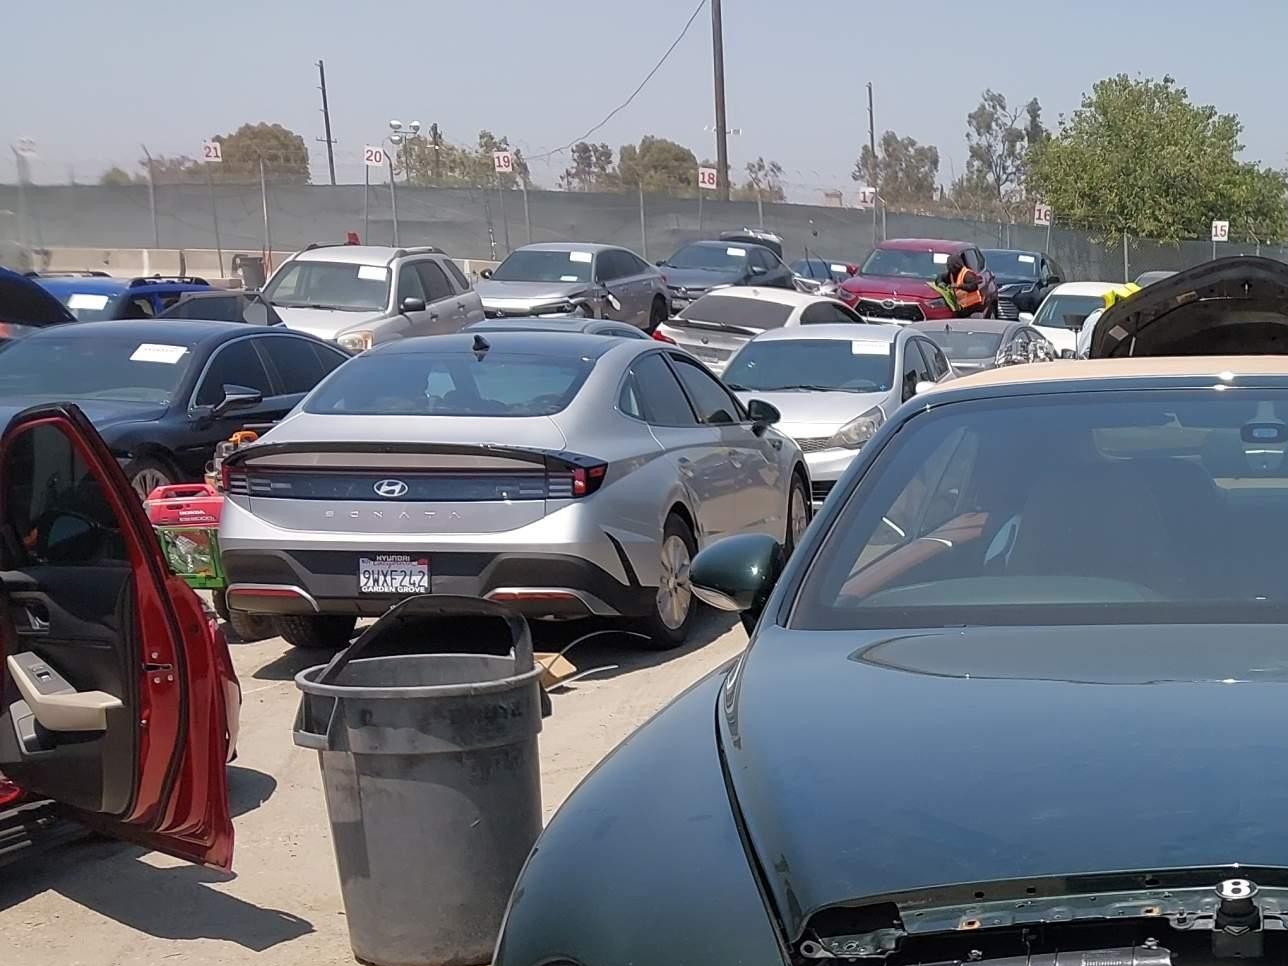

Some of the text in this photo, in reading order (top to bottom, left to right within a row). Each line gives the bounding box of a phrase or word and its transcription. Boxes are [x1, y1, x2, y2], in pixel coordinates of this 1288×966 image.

[204, 145, 220, 158] 21
[366, 149, 382, 163] 20
[495, 155, 510, 168] 19
[699, 171, 715, 185] 18
[860, 191, 875, 204] 17
[1036, 208, 1051, 221] 16
[1213, 224, 1227, 238] 15
[324, 510, 462, 520] SONATA
[362, 569, 427, 588] 9WXF242
[361, 585, 426, 593] GARDEN GROVE
